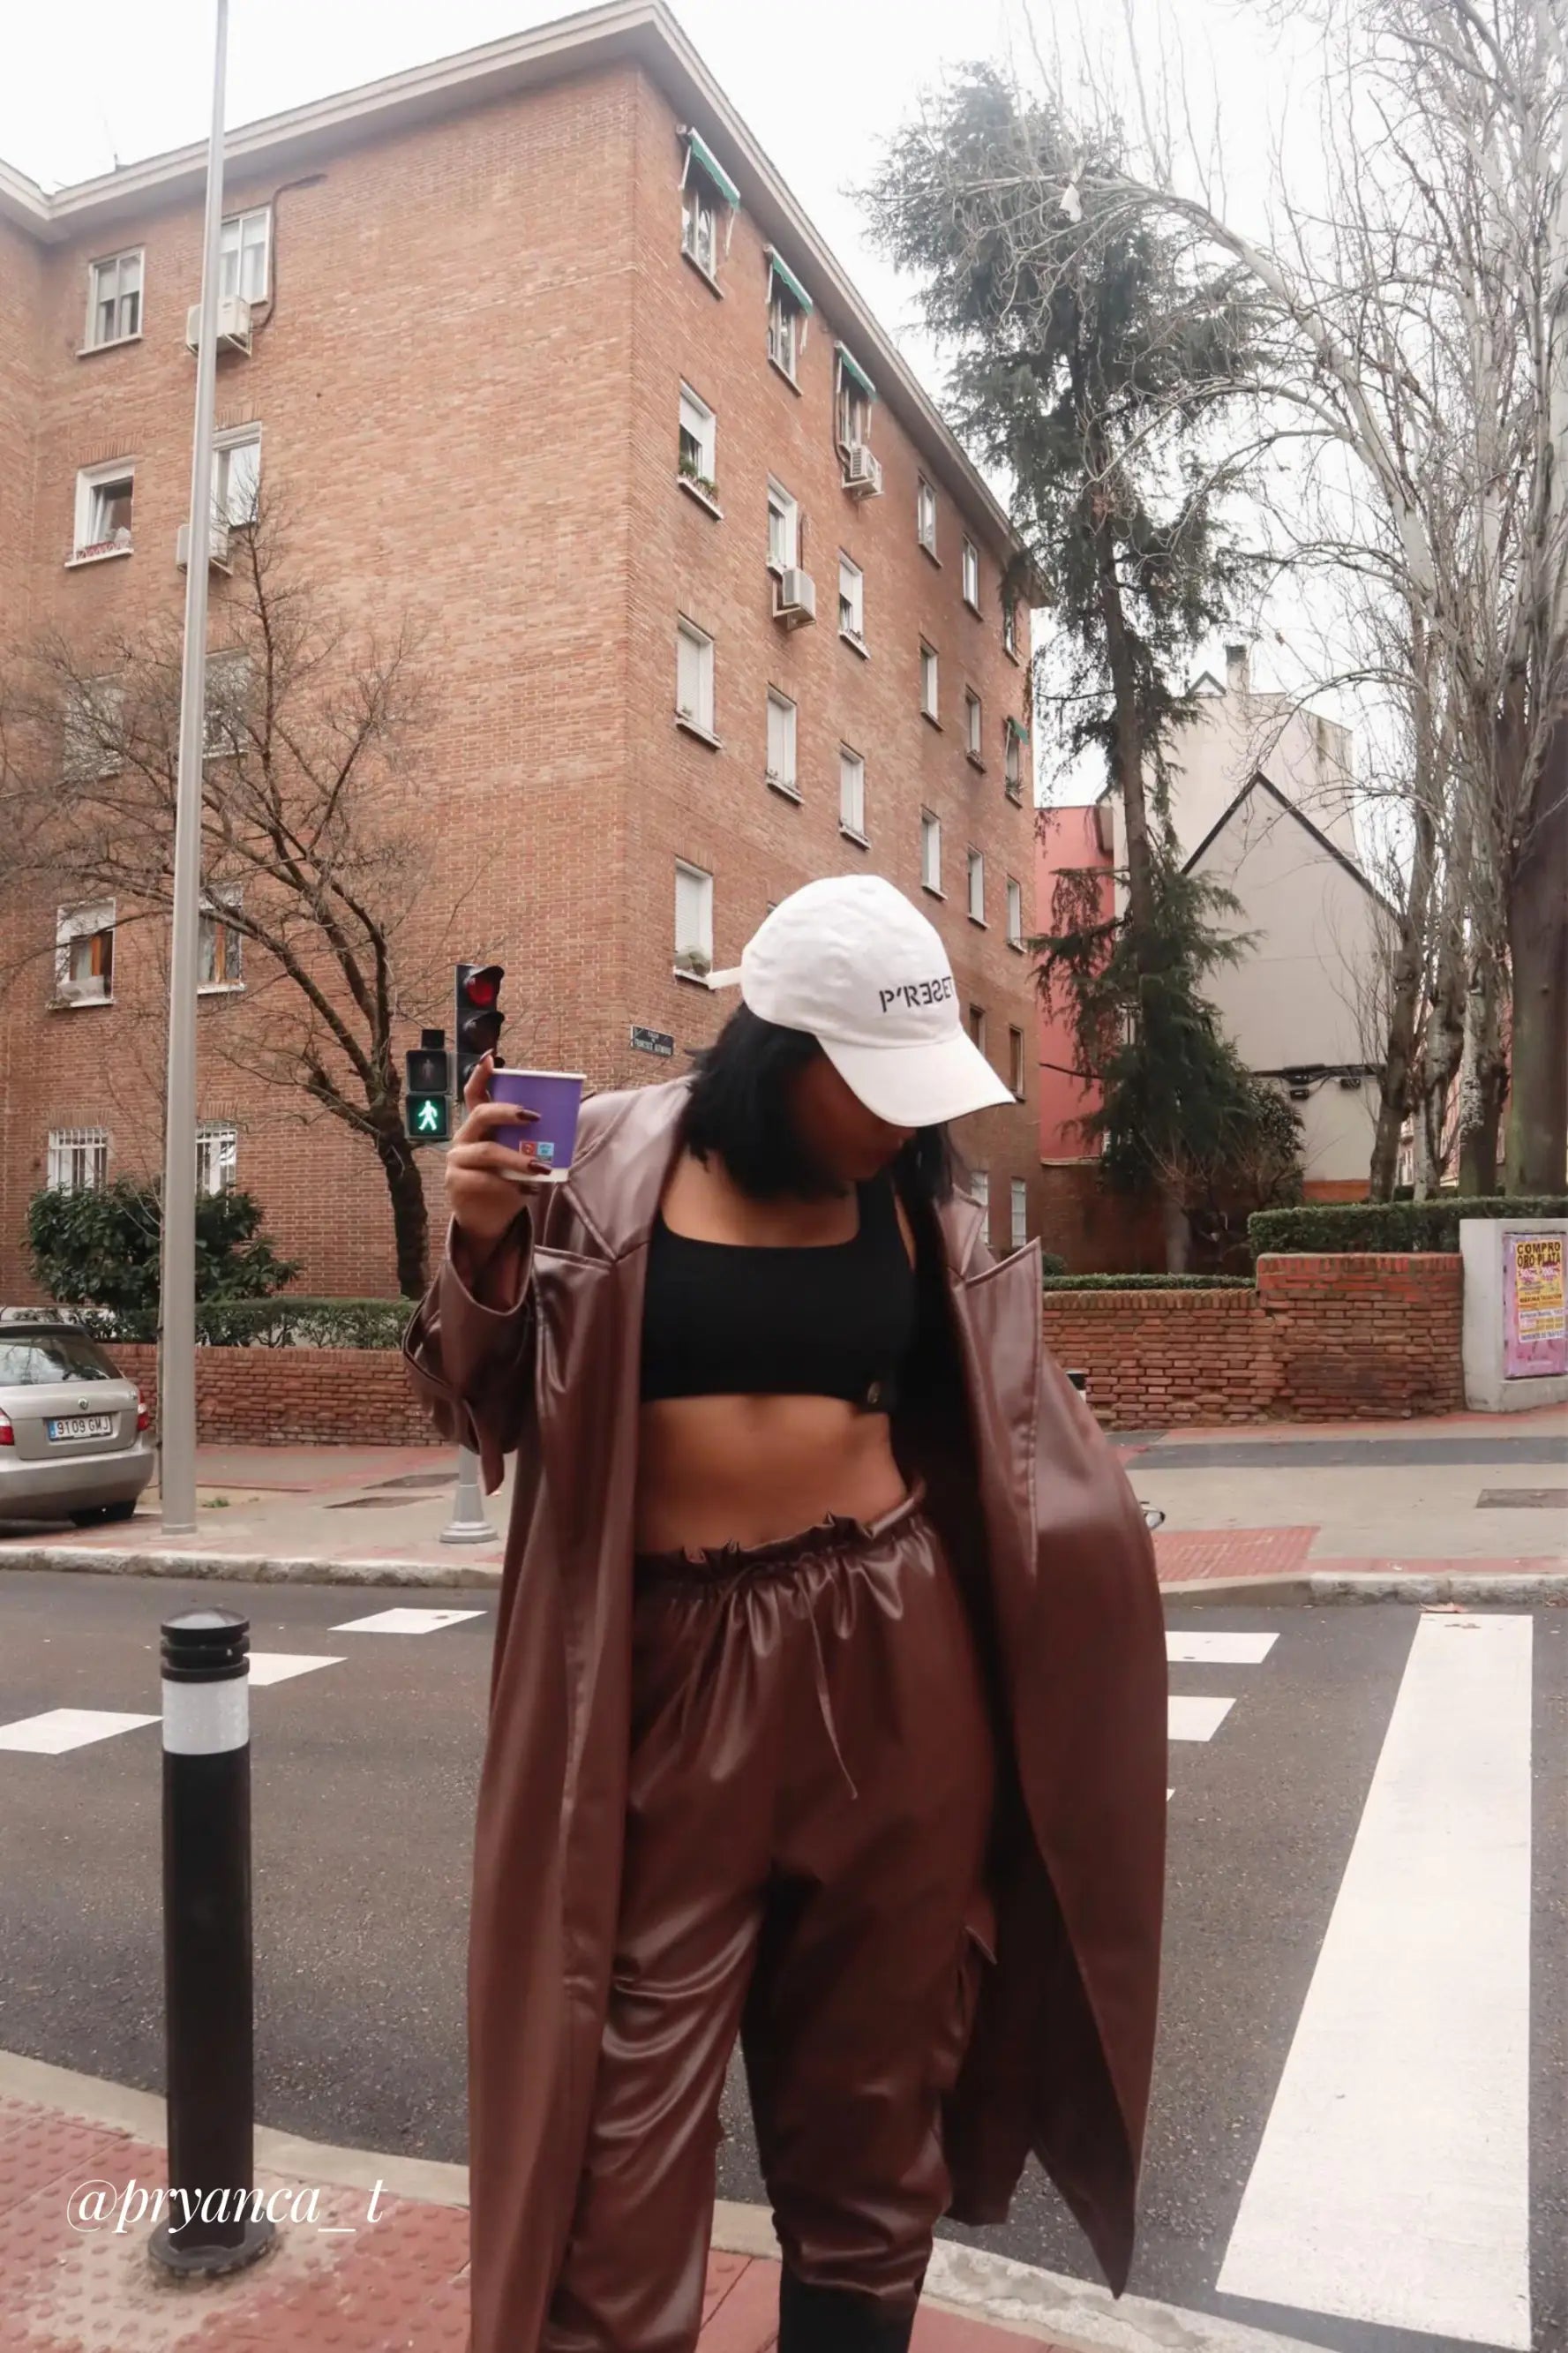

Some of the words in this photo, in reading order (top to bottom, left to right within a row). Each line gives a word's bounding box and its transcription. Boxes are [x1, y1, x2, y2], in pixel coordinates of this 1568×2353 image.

[879, 976, 952, 1013] P'RESE
[1517, 1242, 1561, 1254] COMPRO
[1517, 1254, 1535, 1267] ORO
[1537, 1252, 1561, 1266] PLATA
[56, 1419, 86, 1435] 9109
